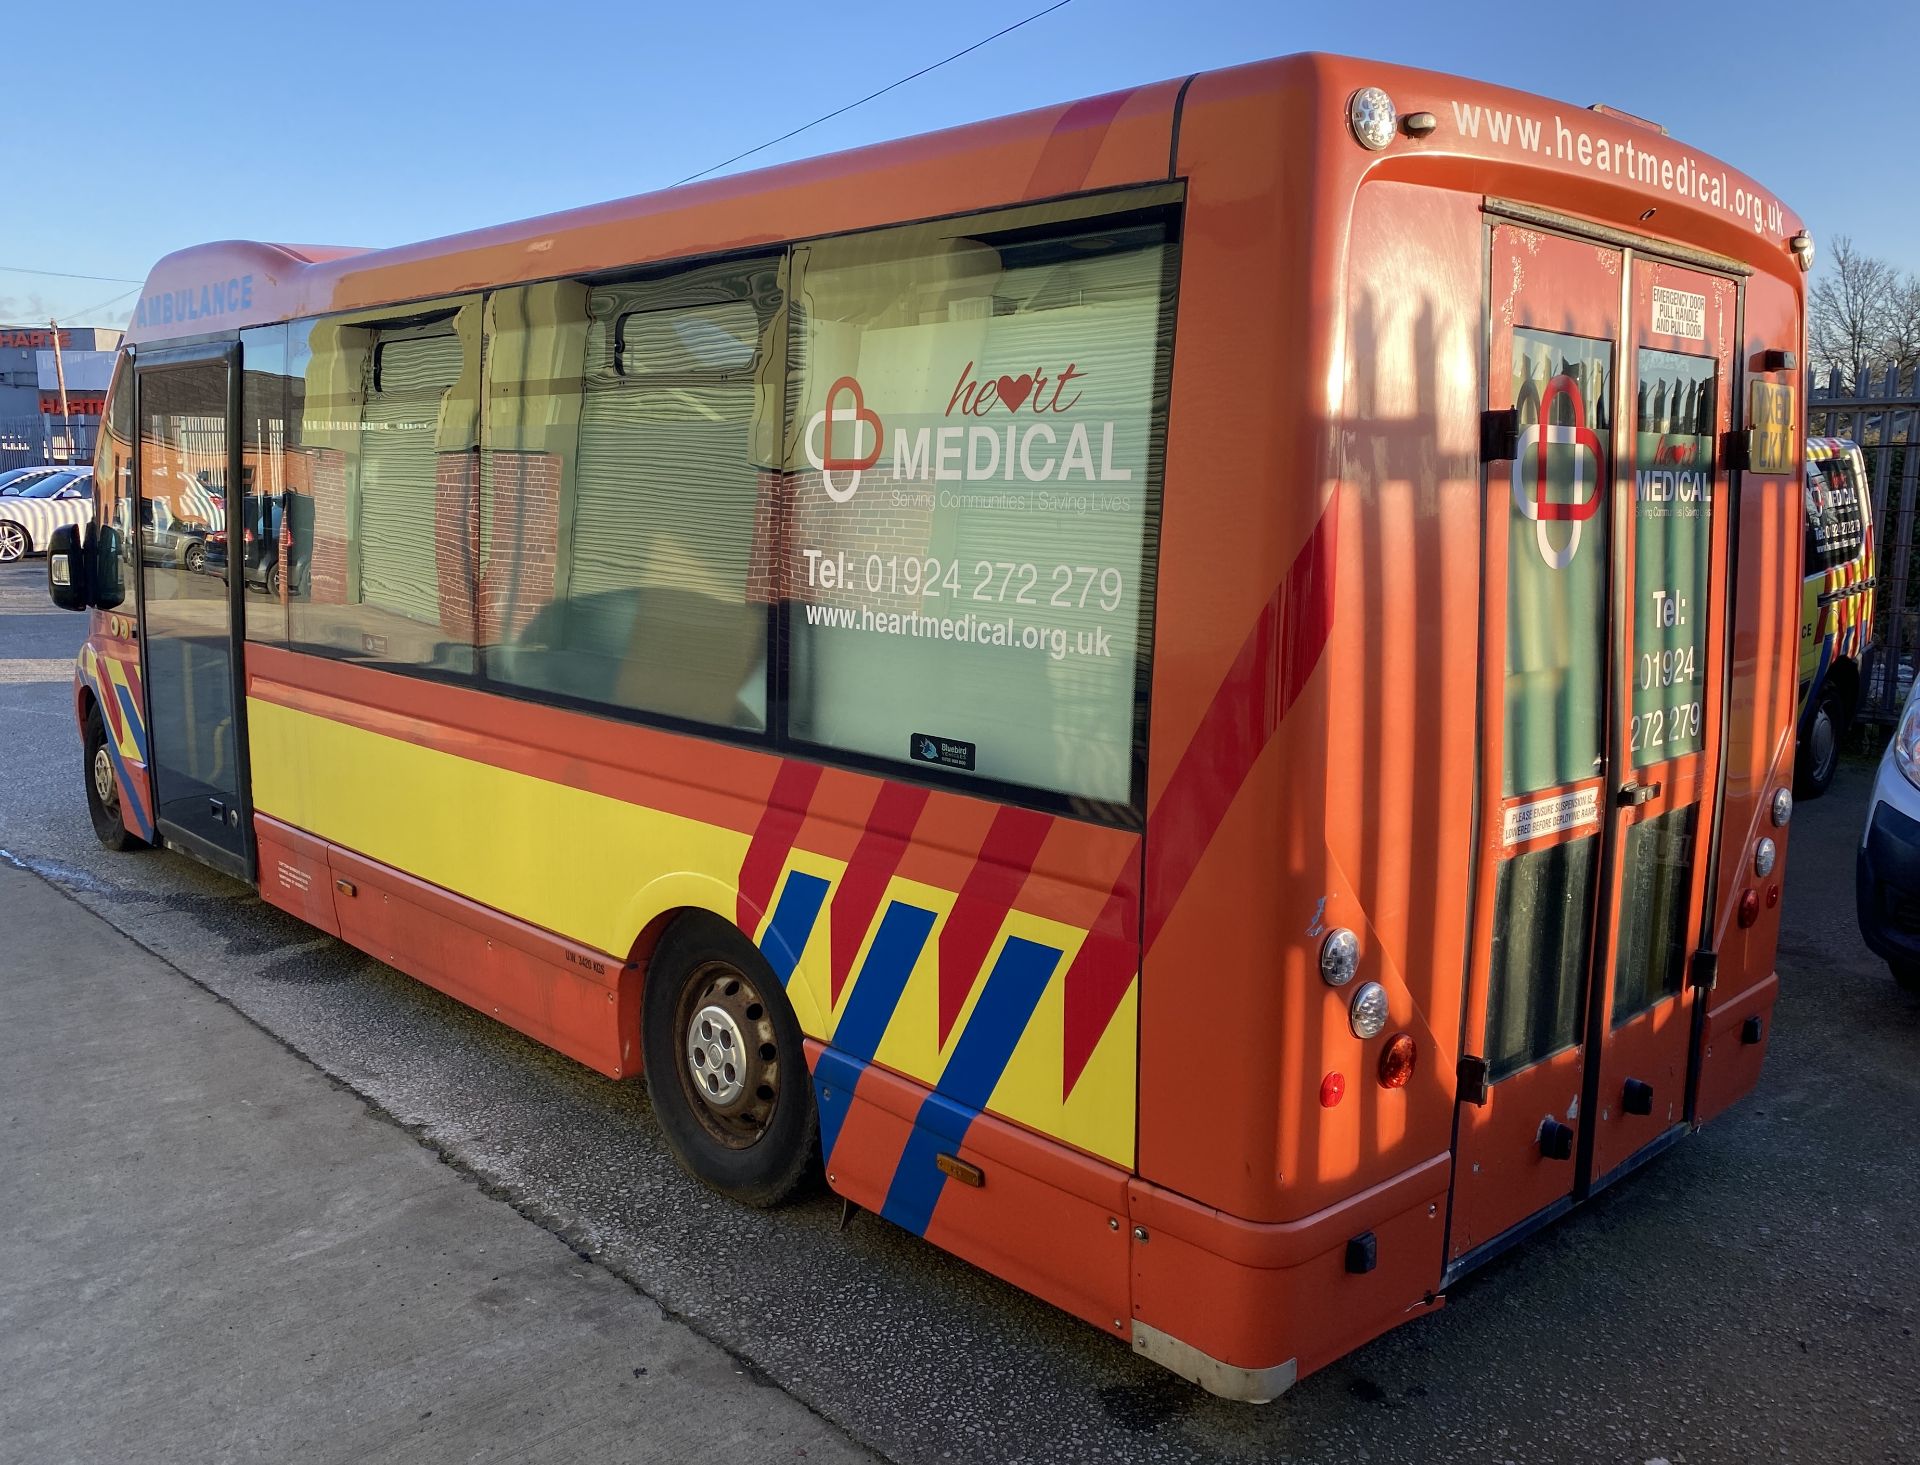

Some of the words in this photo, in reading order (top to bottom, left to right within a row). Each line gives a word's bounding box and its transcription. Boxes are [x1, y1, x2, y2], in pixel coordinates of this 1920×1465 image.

[1451, 100, 1786, 237] www.heartmedical.org.uk
[136, 274, 253, 328] AMBULANCE
[1653, 288, 1688, 308] EMERGENCY
[1689, 295, 1705, 311] DOOR
[1659, 303, 1674, 319] PULL
[1675, 306, 1699, 323] HANDLE
[1656, 317, 1670, 333] AND
[1670, 320, 1685, 335] PULL
[1685, 322, 1702, 338] DOOR
[892, 421, 1132, 482] MEDICAL
[890, 489, 936, 511] Serving
[939, 489, 1026, 511] Communities
[1038, 491, 1087, 515] Saving
[1091, 491, 1131, 512] Lives
[1635, 469, 1712, 502] MEDICAL
[803, 549, 854, 590] Tel:
[864, 553, 962, 598] 01924
[972, 560, 1038, 604] 272
[1049, 565, 1123, 612] 279
[1652, 589, 1686, 628] Tel:
[805, 604, 1112, 660] www.heartmedical.org.uk
[1640, 645, 1695, 690] 01924
[1630, 709, 1664, 752] 272
[1668, 701, 1701, 741] 279
[941, 743, 967, 755] Bluebird
[1505, 824, 1531, 840] LOWERED
[1532, 817, 1552, 832] BEFORE
[1552, 811, 1581, 827] DEPLOYING
[1580, 806, 1596, 818] RAMP
[1512, 809, 1533, 824] PLEASE
[1533, 804, 1554, 818] ENSURE
[1554, 796, 1586, 812] SUSPENSION
[1586, 794, 1593, 805] IS
